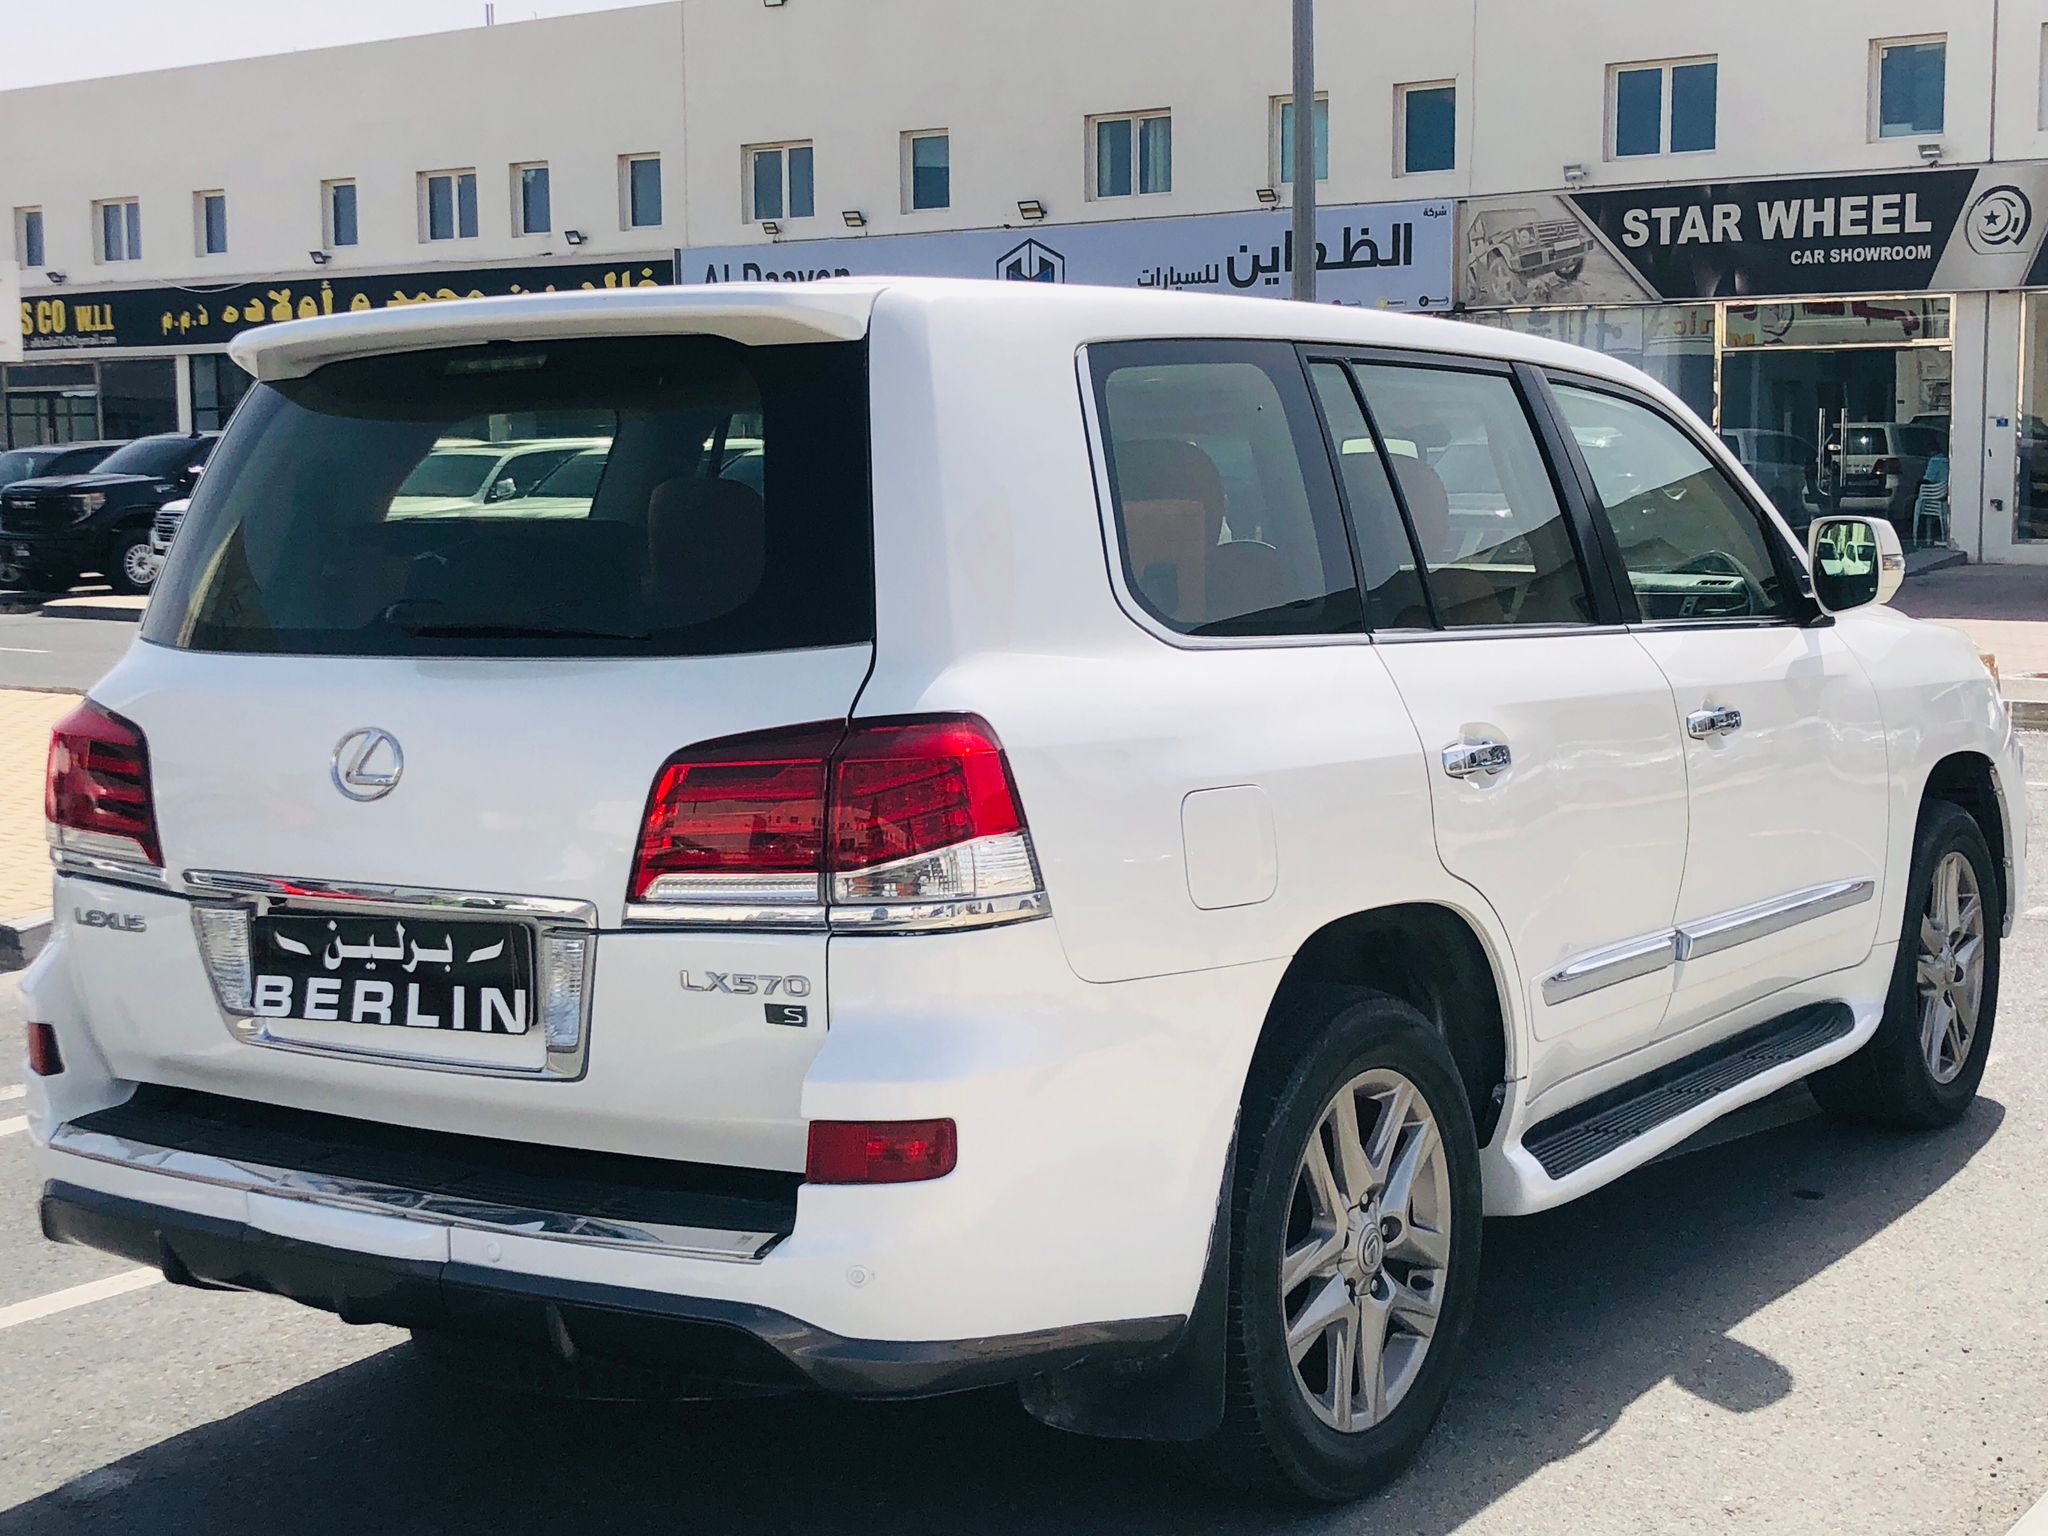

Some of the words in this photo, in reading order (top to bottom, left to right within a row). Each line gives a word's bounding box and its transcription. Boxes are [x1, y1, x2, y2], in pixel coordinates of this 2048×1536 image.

[1423, 205, 1447, 218] شركة
[1622, 203, 1743, 247] STAR
[1757, 193, 1932, 239] WHEEL
[1790, 250, 1824, 265] CAR
[1830, 245, 1931, 263] SHOWROOM
[1137, 264, 1219, 290] للسيارات
[38, 300, 66, 334] CO
[74, 907, 147, 932] LEXUS
[322, 919, 454, 974] برلين
[680, 970, 811, 998] LX570
[254, 975, 526, 1034] BERLIN
[783, 1008, 804, 1024] S
